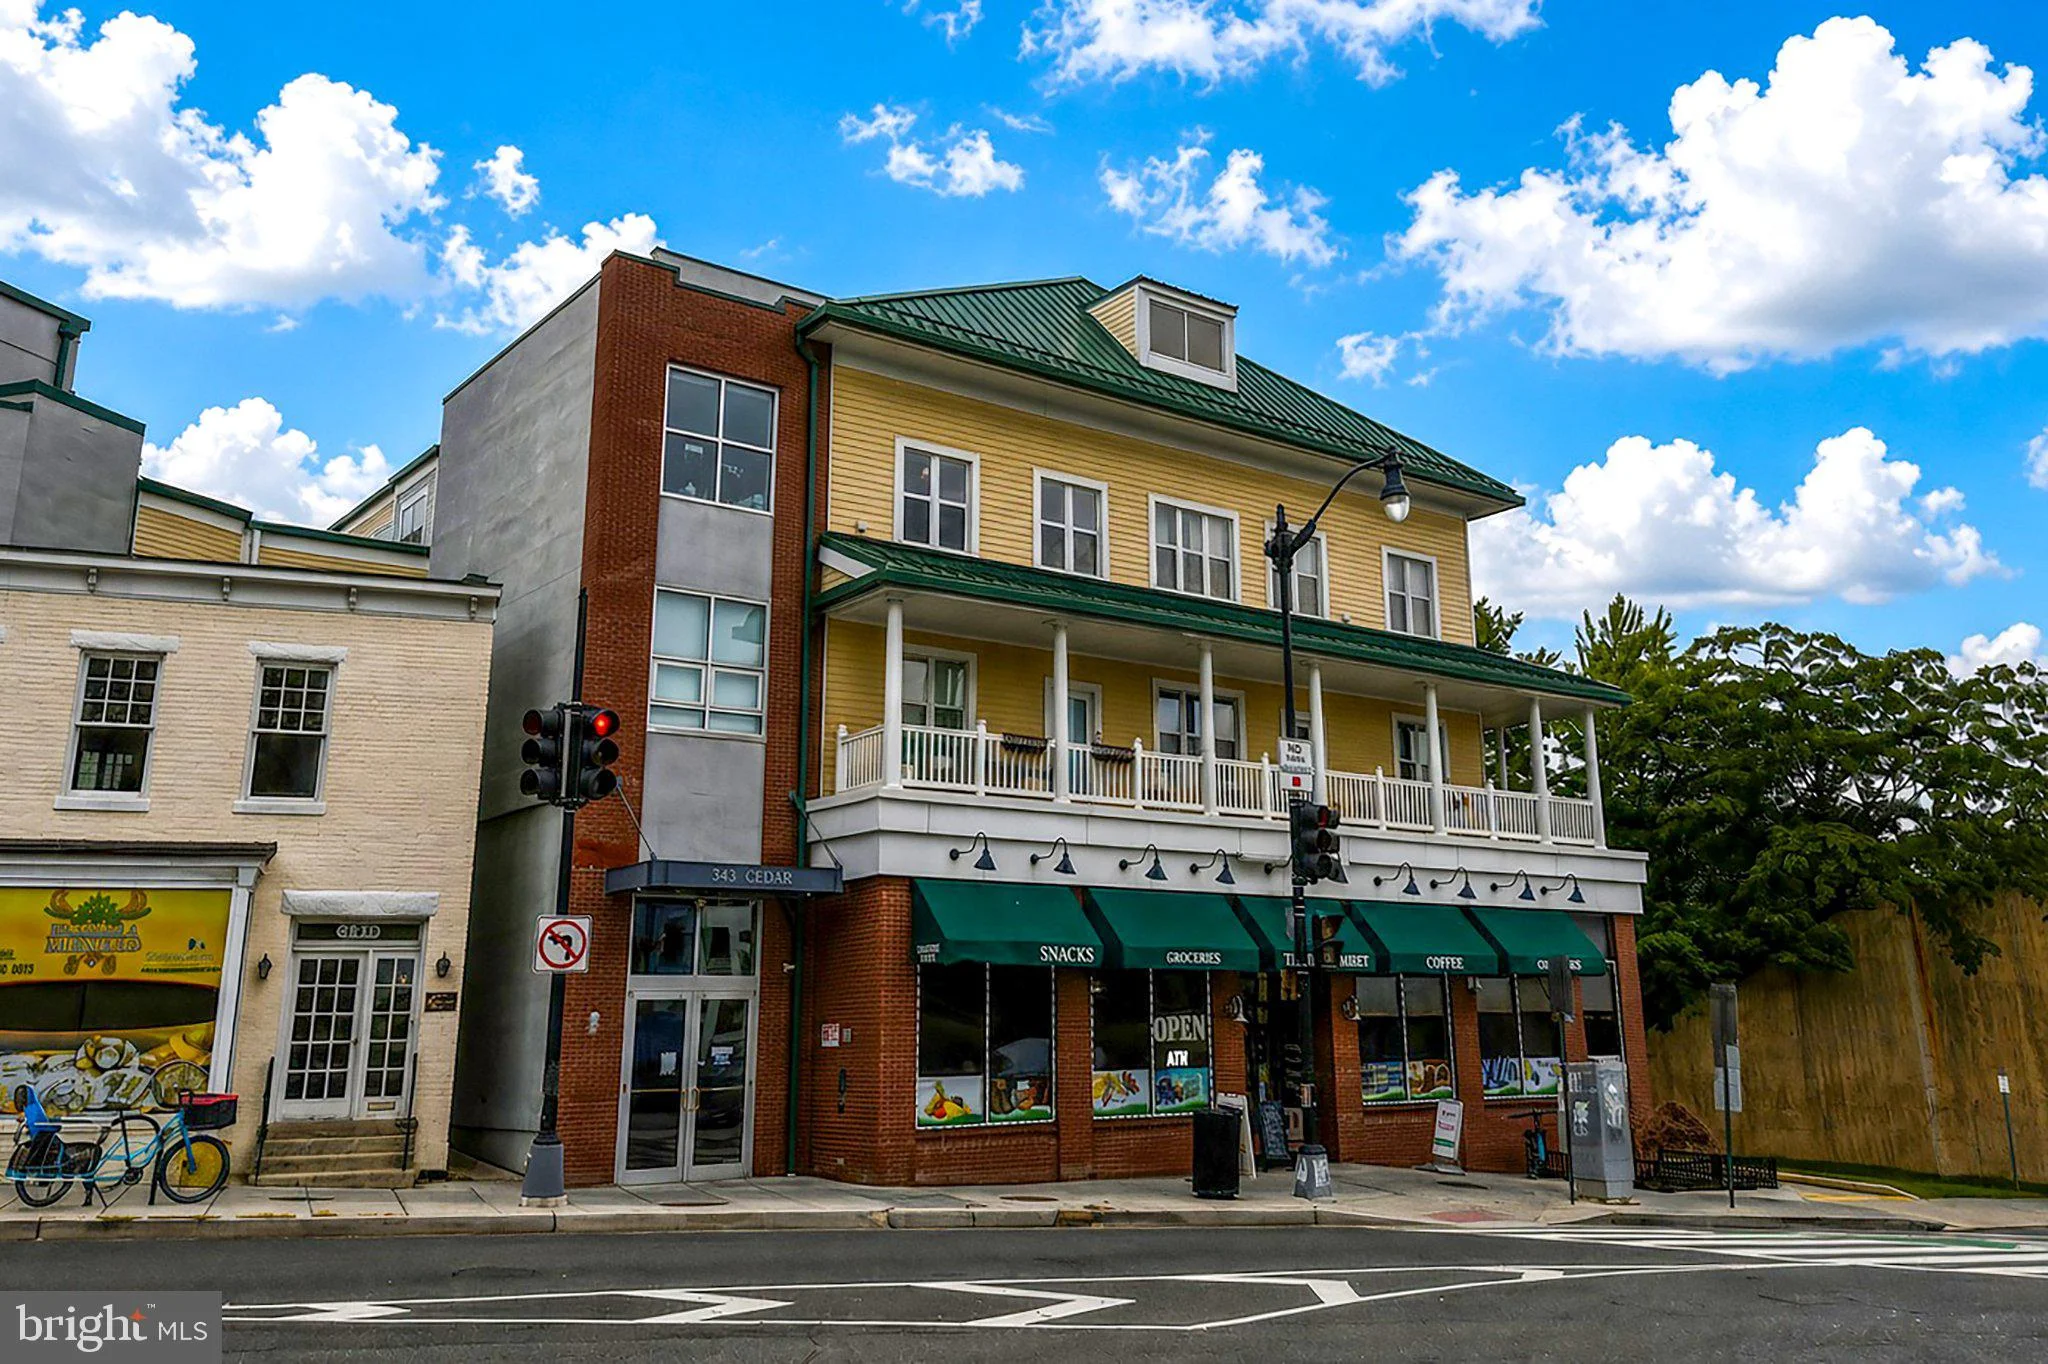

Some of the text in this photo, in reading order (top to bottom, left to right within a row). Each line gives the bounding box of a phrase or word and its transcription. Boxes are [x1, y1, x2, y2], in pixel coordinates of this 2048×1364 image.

[712, 868, 793, 885] 343 CEDAR
[1039, 945, 1095, 963] SNACKS
[1166, 951, 1222, 965] GROCERIES
[1426, 956, 1465, 969] COFFEE
[1153, 1014, 1206, 1042] OPEN
